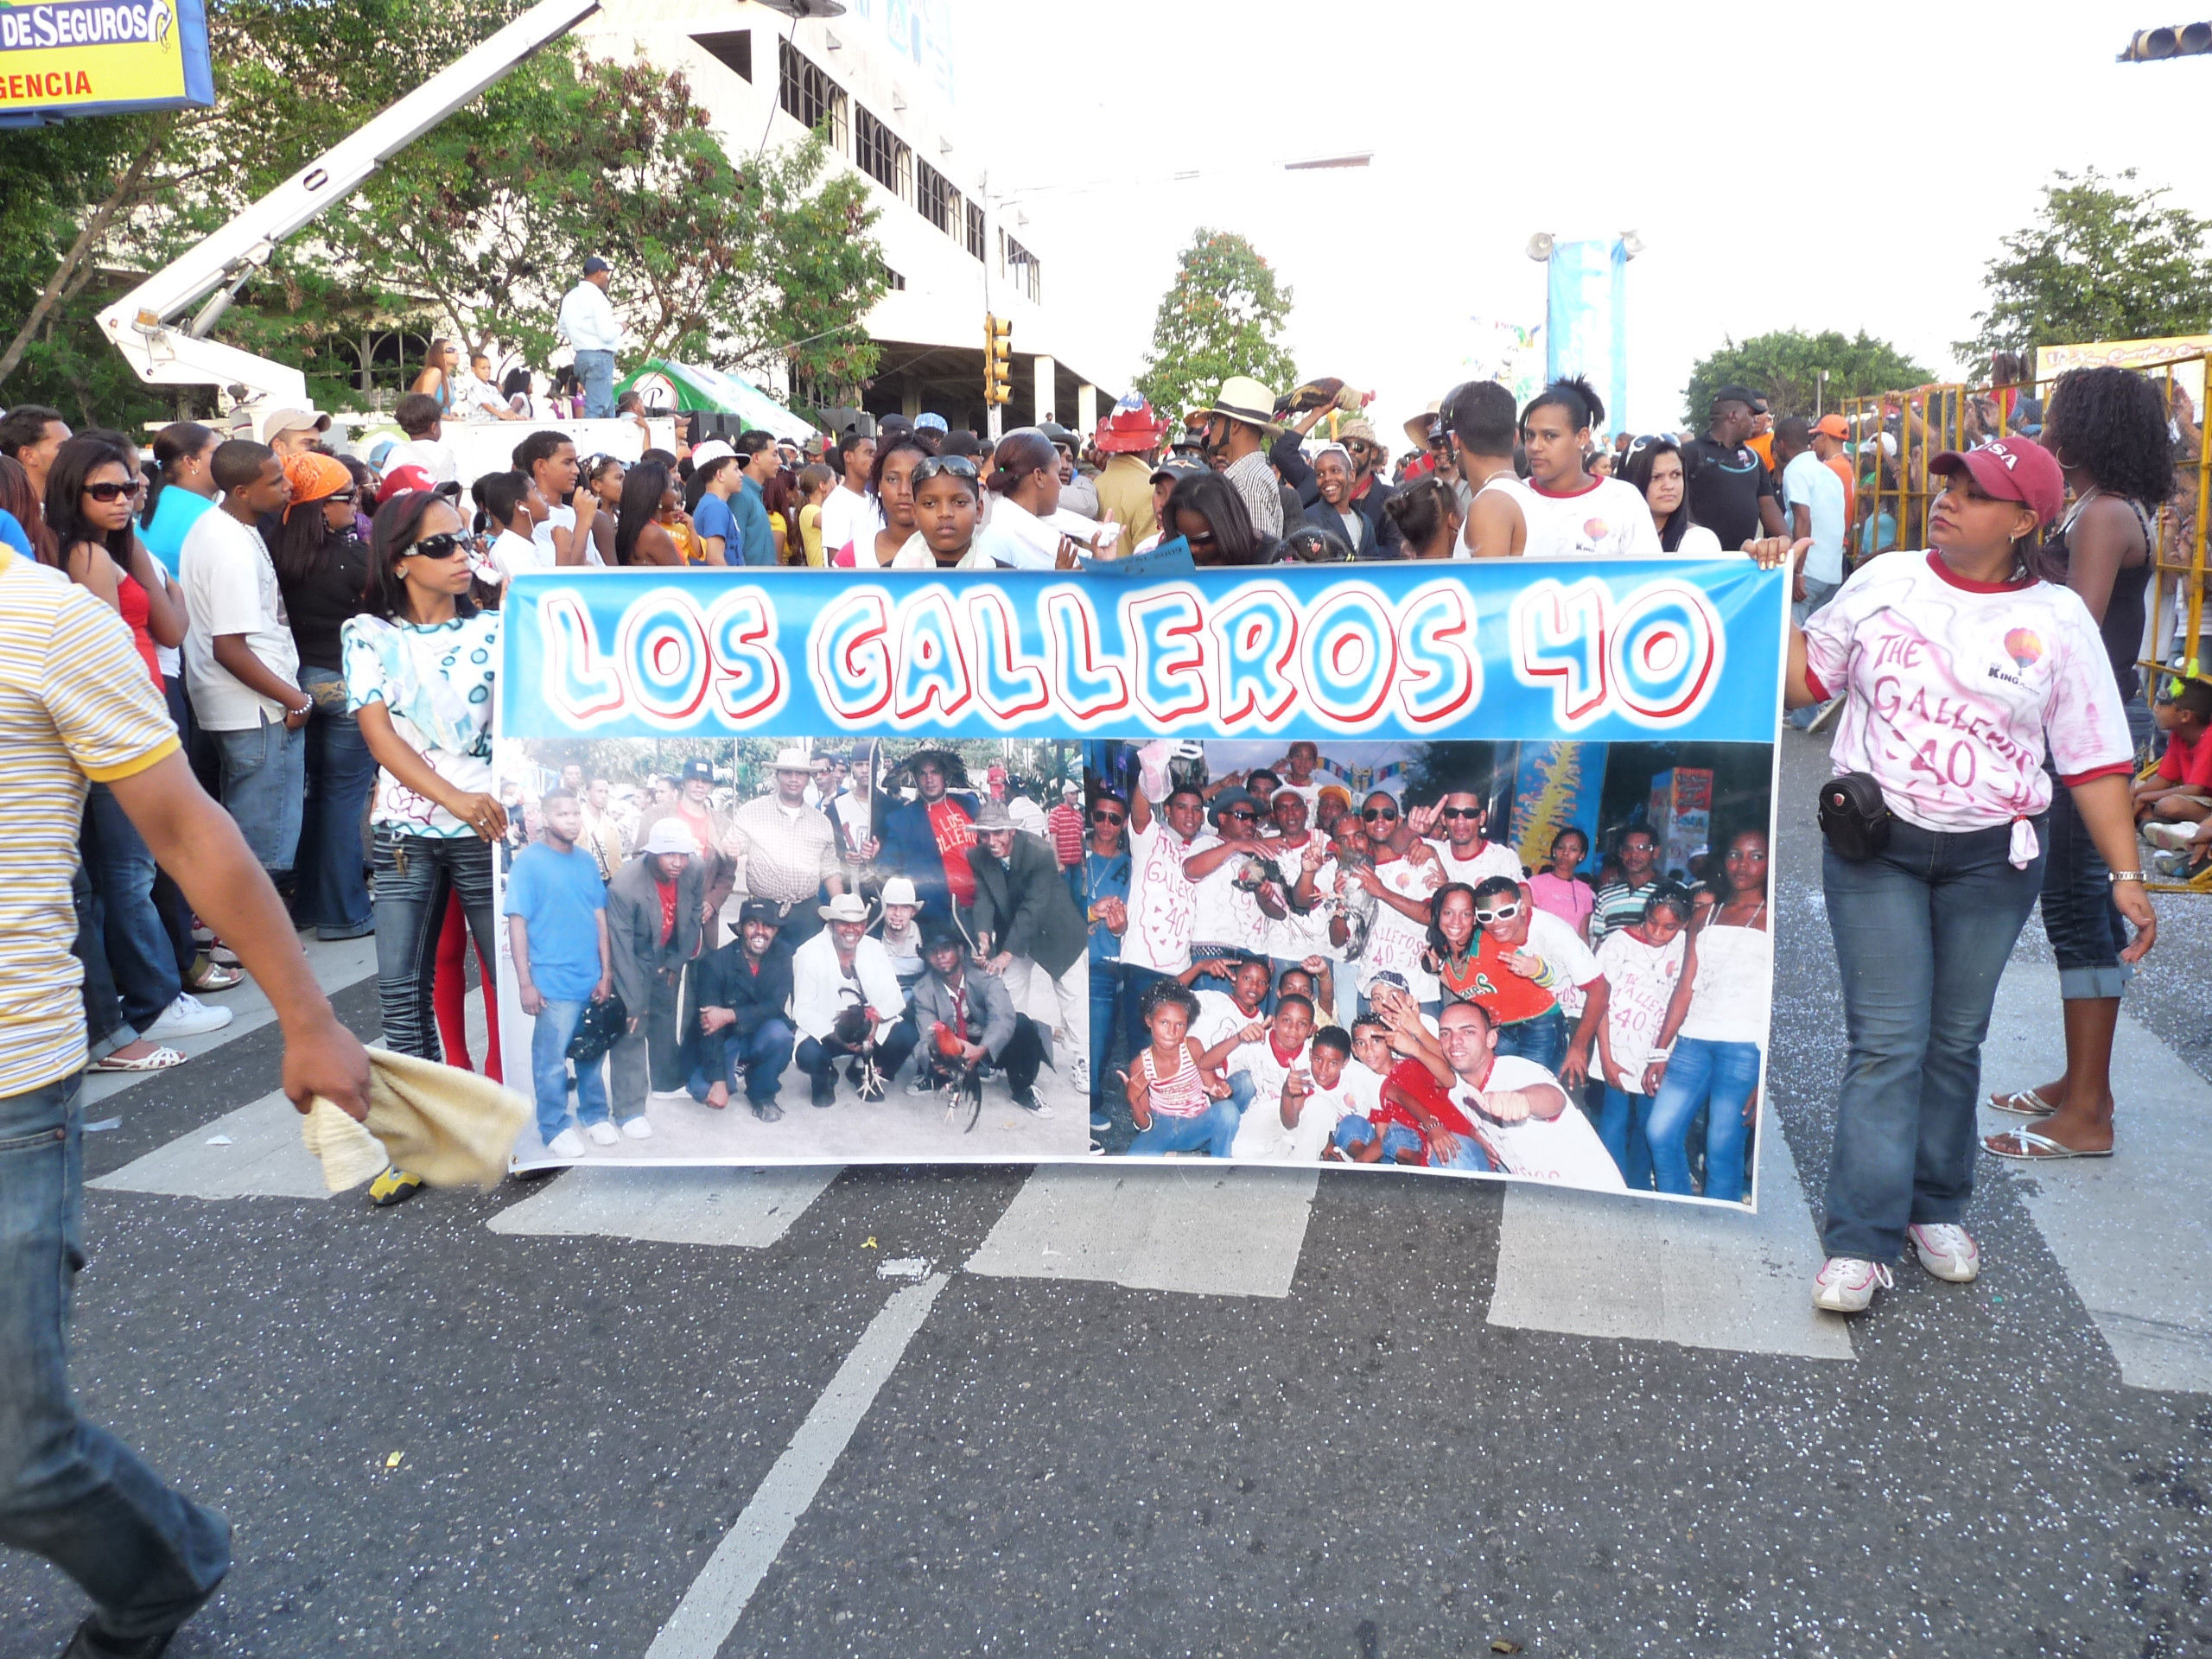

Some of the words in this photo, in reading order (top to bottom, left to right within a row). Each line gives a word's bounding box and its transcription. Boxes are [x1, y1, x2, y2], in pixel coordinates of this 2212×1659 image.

[543, 588, 785, 728] LOS
[810, 582, 1477, 730] GALLEROS
[1512, 580, 1722, 732] 40
[1873, 635, 1928, 671] THE
[1910, 739, 1976, 788] 40
